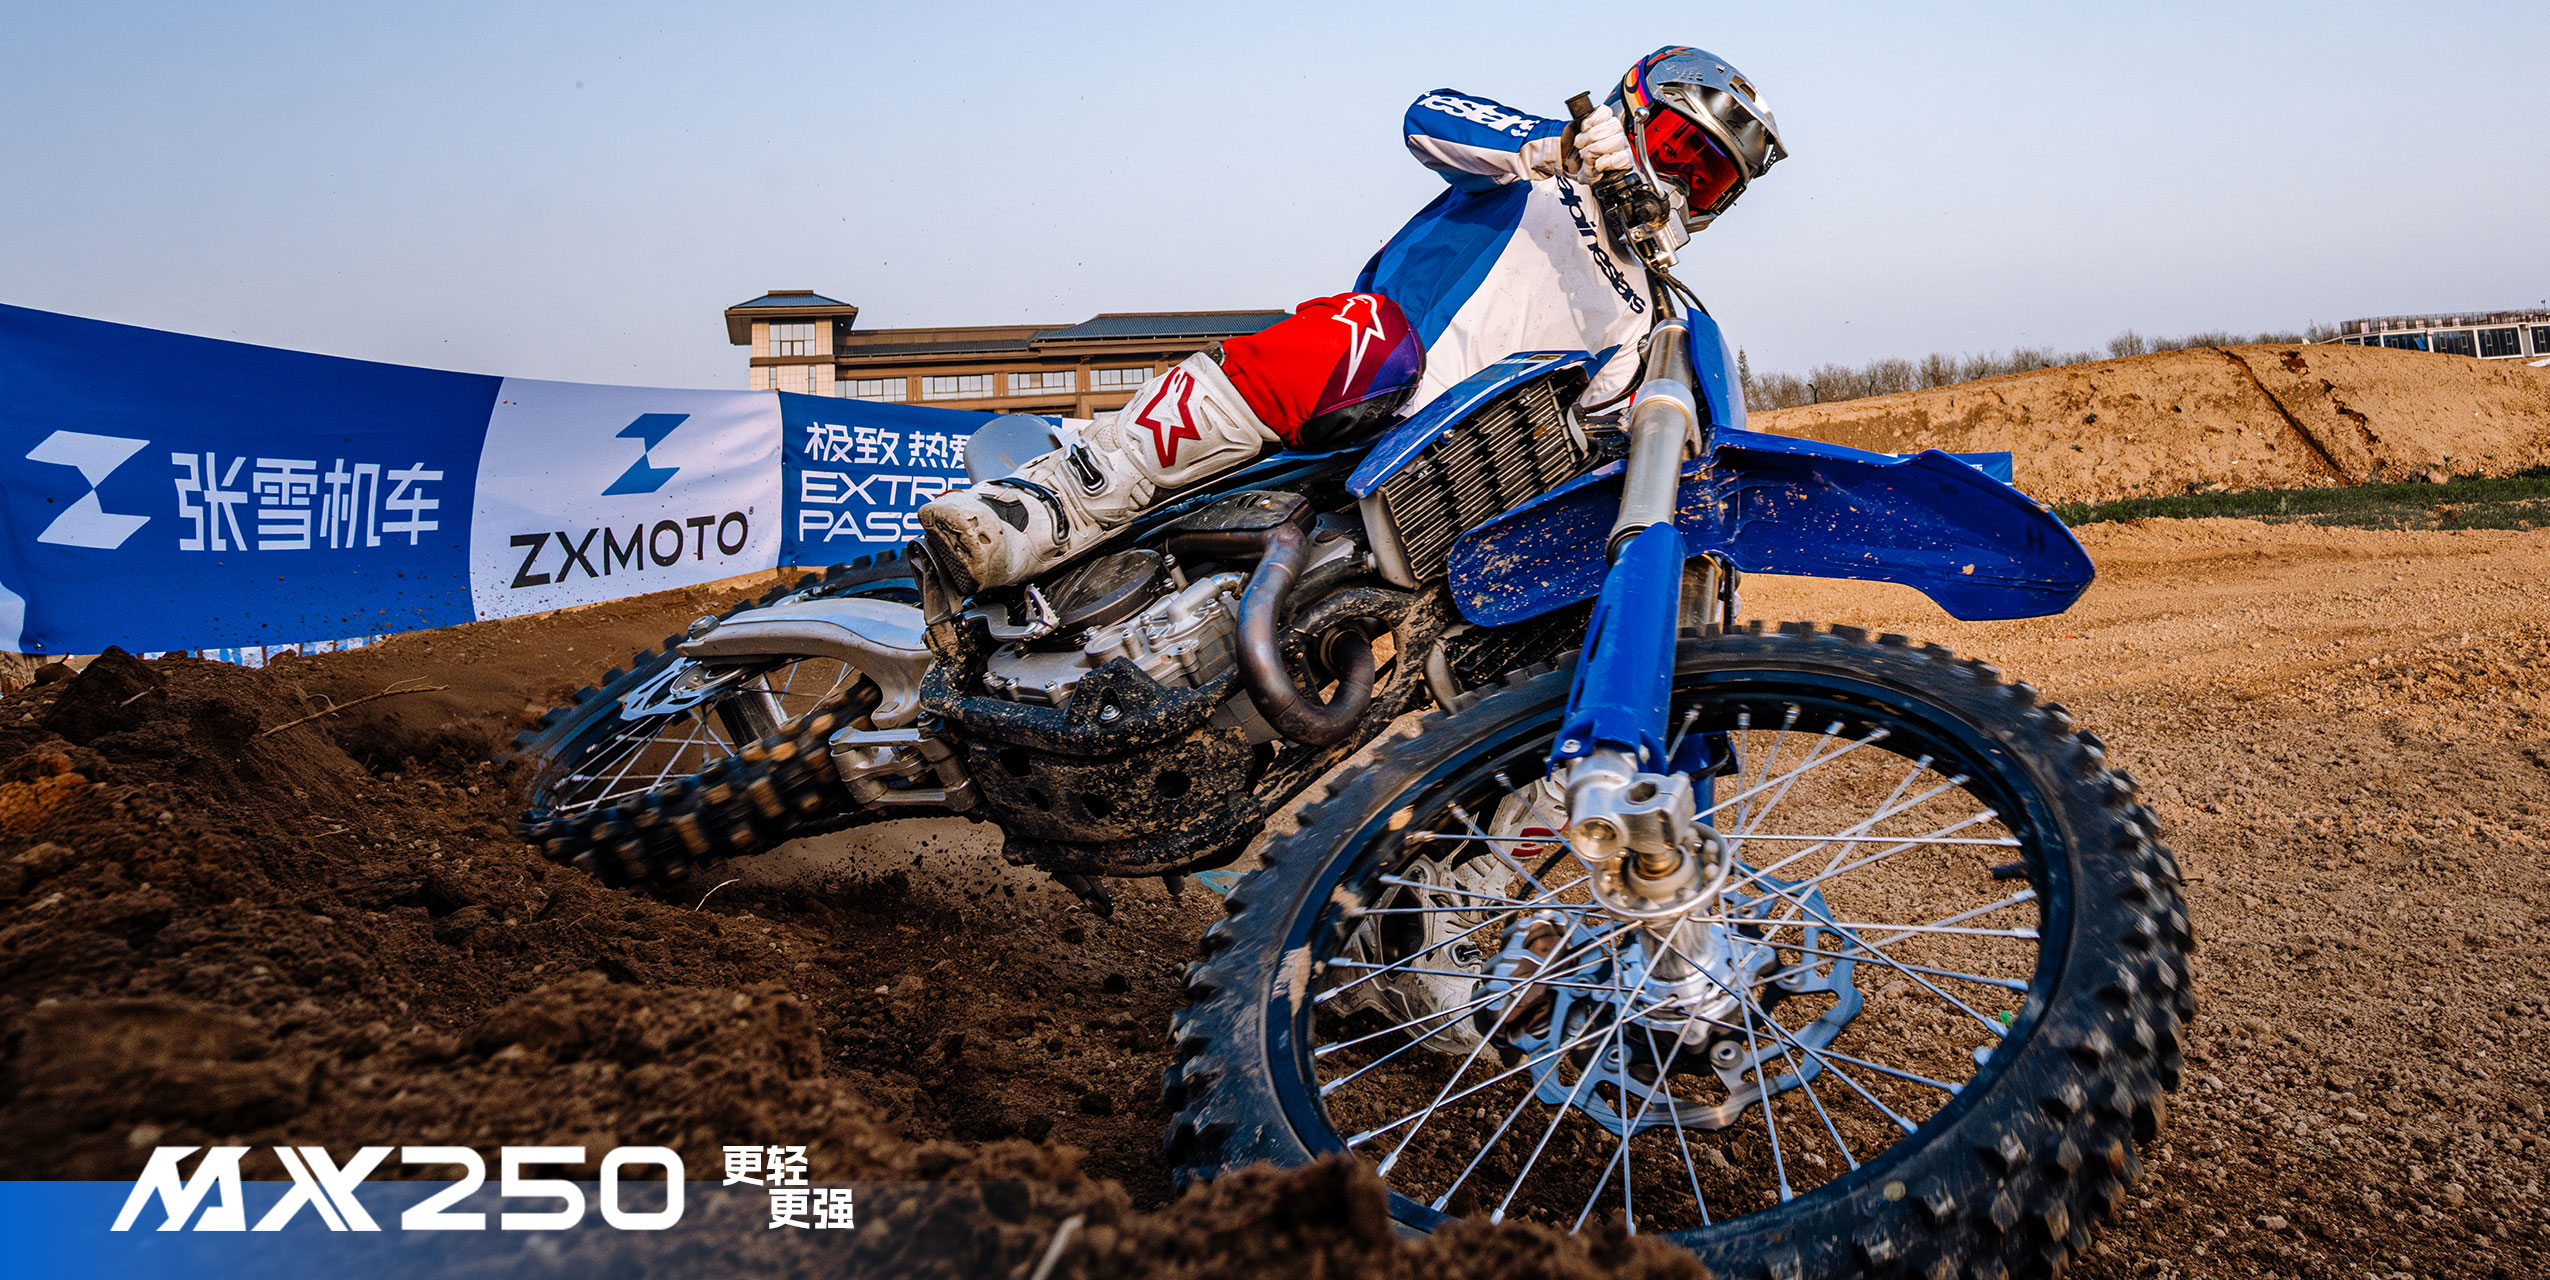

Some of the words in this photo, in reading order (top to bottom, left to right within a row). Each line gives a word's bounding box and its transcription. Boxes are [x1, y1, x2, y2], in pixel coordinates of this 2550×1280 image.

[804, 421, 900, 466] 极致
[171, 452, 444, 552] 张雪机车
[510, 511, 749, 590] ZXMOTO
